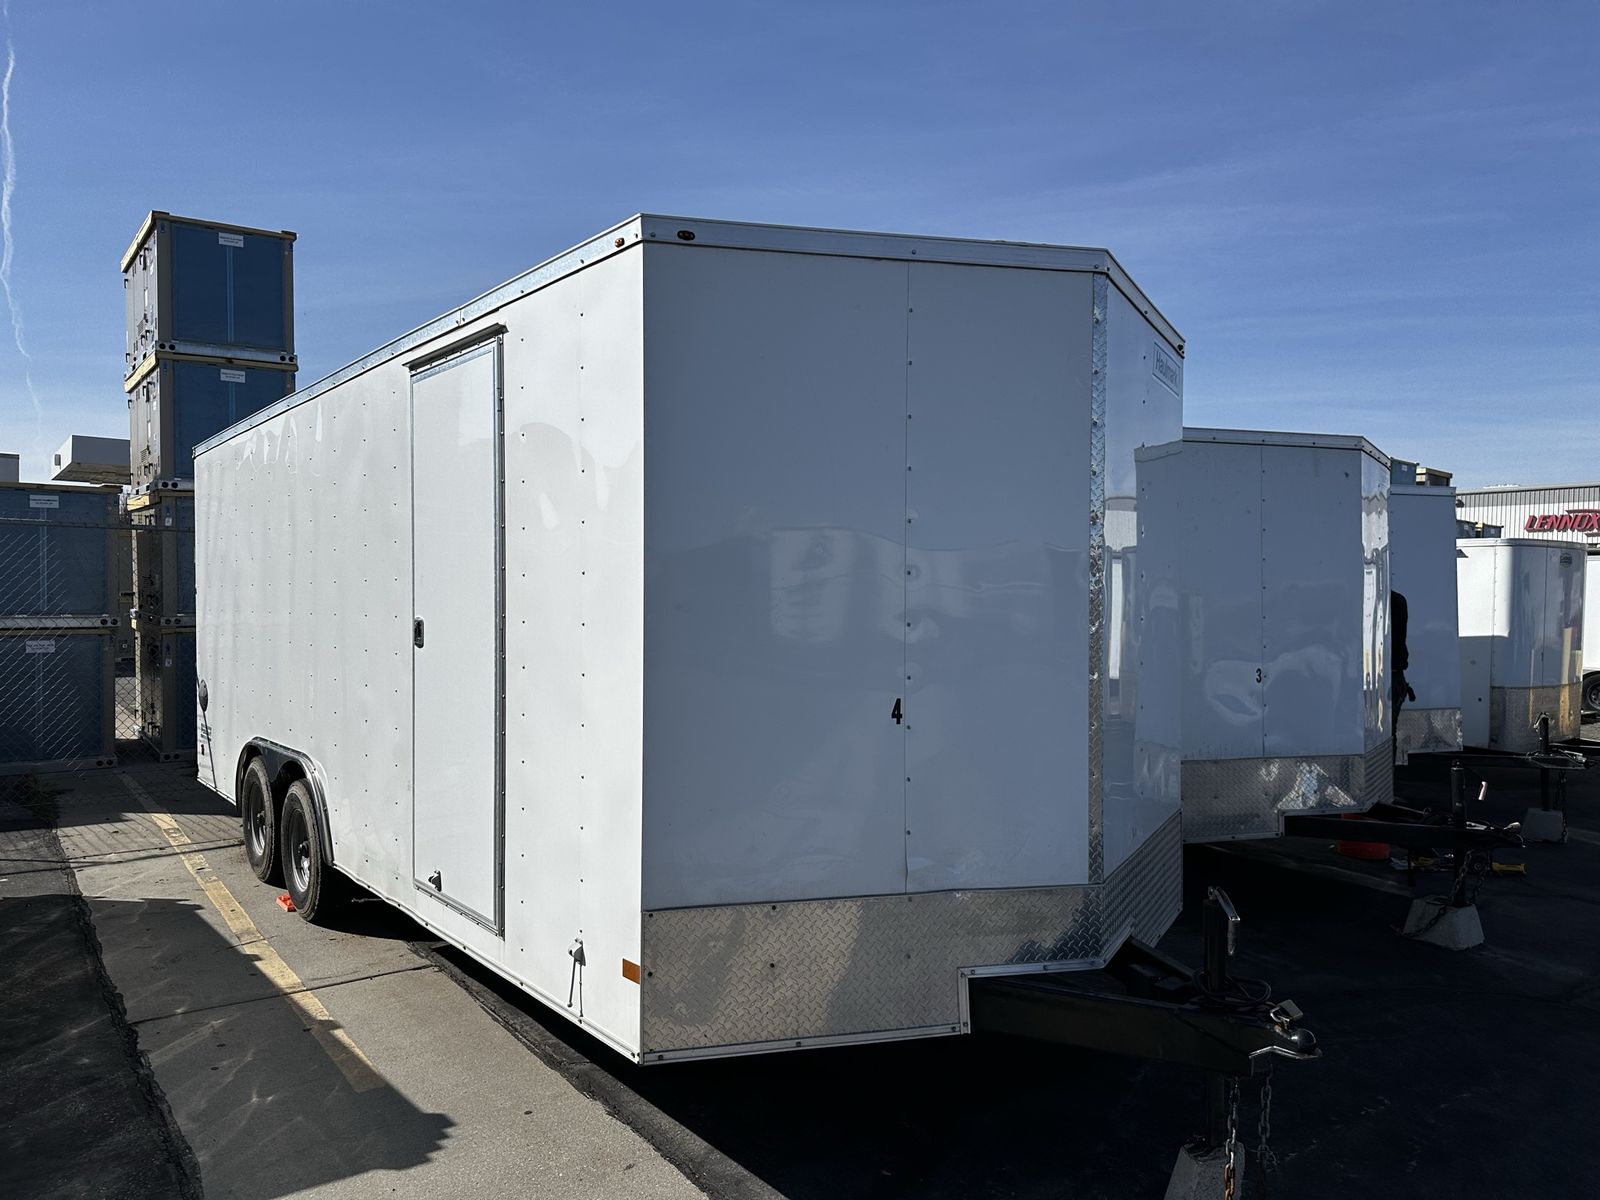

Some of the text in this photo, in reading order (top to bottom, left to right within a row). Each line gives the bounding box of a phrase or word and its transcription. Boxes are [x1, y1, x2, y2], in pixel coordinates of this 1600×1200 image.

[1524, 510, 1600, 534] LENNOX
[1256, 668, 1262, 683] 3
[891, 697, 903, 725] 4
